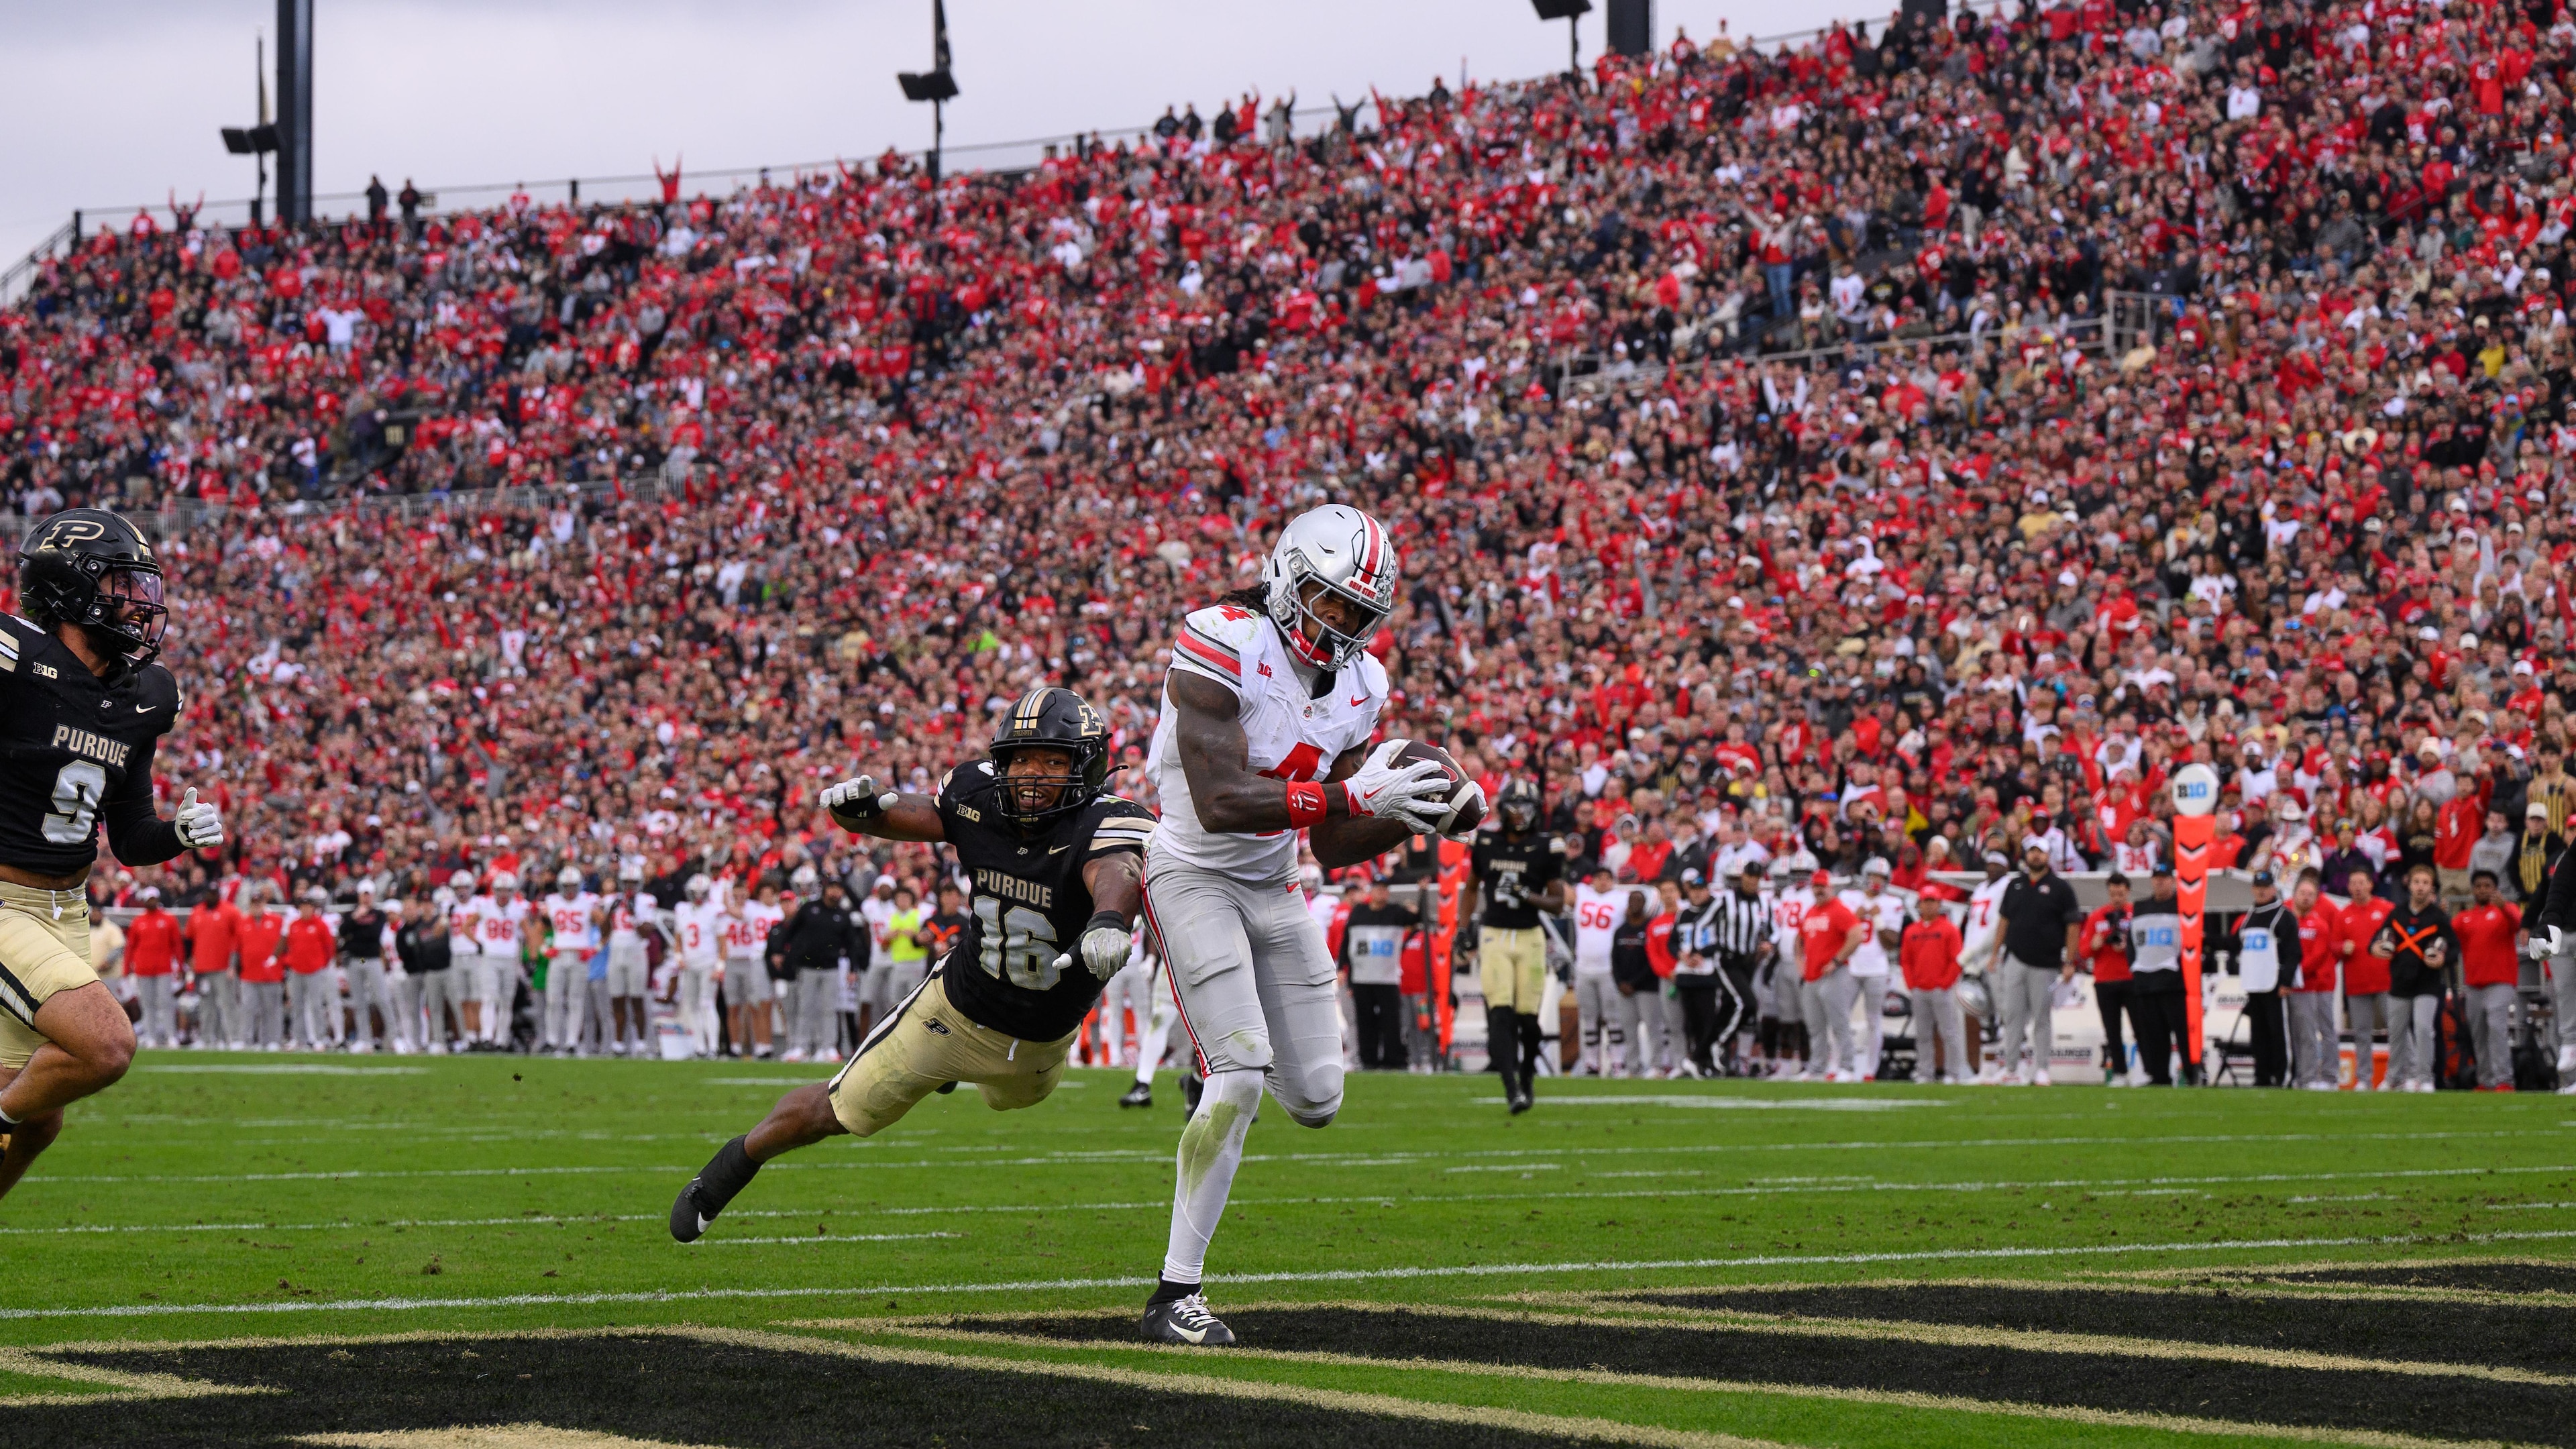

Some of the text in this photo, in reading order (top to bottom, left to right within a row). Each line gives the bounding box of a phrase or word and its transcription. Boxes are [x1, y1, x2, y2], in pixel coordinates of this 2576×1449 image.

[39, 520, 105, 549] P
[1348, 580, 1376, 599] OHIO STATE
[51, 723, 131, 768] PURDUE
[41, 759, 106, 844] 9
[1018, 847, 1028, 855] P
[1489, 859, 1527, 873] PURDUE
[975, 868, 1052, 908] PURDUE
[1580, 901, 1614, 929] 56
[688, 922, 699, 948] 3
[974, 895, 1061, 991] 16
[920, 1016, 953, 1037] P
